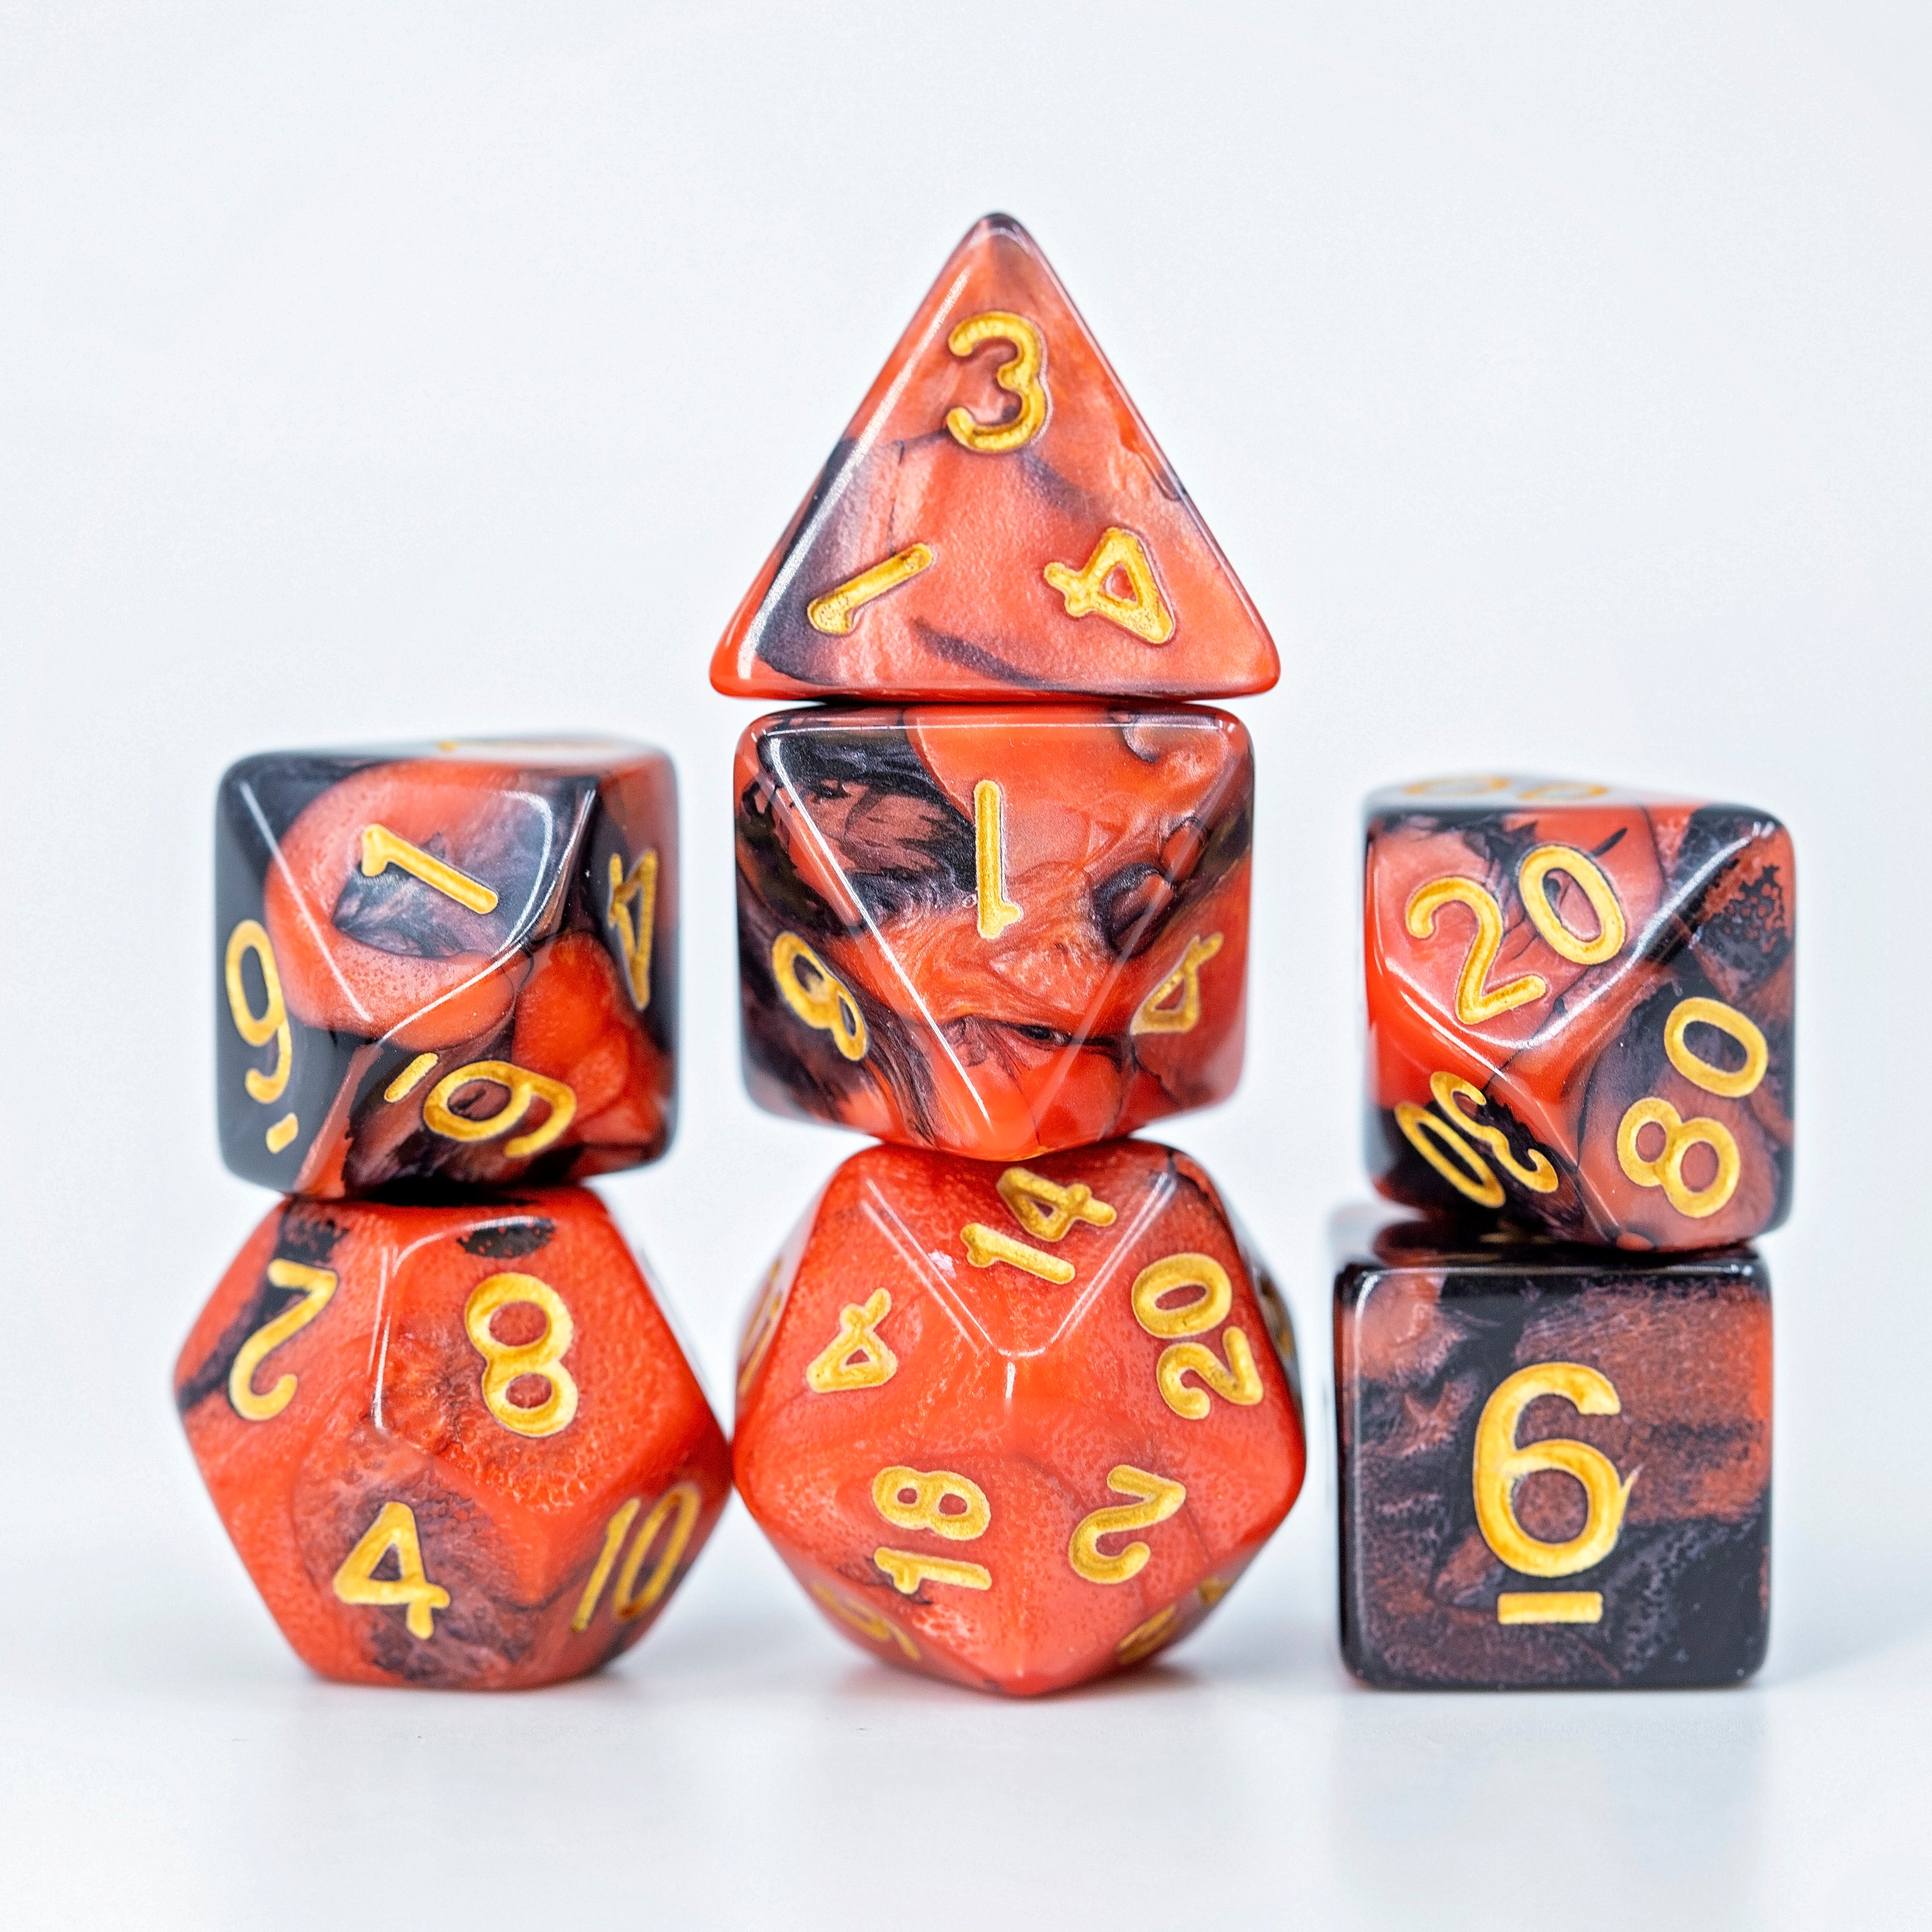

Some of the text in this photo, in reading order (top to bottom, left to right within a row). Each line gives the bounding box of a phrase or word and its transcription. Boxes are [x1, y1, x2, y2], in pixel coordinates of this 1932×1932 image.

[946, 310, 1050, 452] 3
[807, 542, 935, 634] 1
[1043, 527, 1175, 645] 4
[362, 823, 499, 915] 1
[974, 779, 1022, 938] 1
[608, 849, 658, 1009] 4
[772, 932, 868, 1061] 8
[1131, 933, 1225, 1034] 4
[1406, 844, 1626, 1025] 20
[1395, 1071, 1559, 1209] 30
[1617, 997, 1768, 1219] 80
[960, 1167, 1117, 1285] 14
[228, 1258, 338, 1421] 2
[465, 1272, 579, 1438] 8
[806, 1287, 898, 1393] 4
[1131, 1253, 1263, 1420] 20
[872, 1465, 993, 1594] 18
[1069, 1465, 1186, 1584] 2
[1473, 1360, 1632, 1578] 6
[333, 1501, 451, 1640] 4
[571, 1484, 701, 1634] 10
